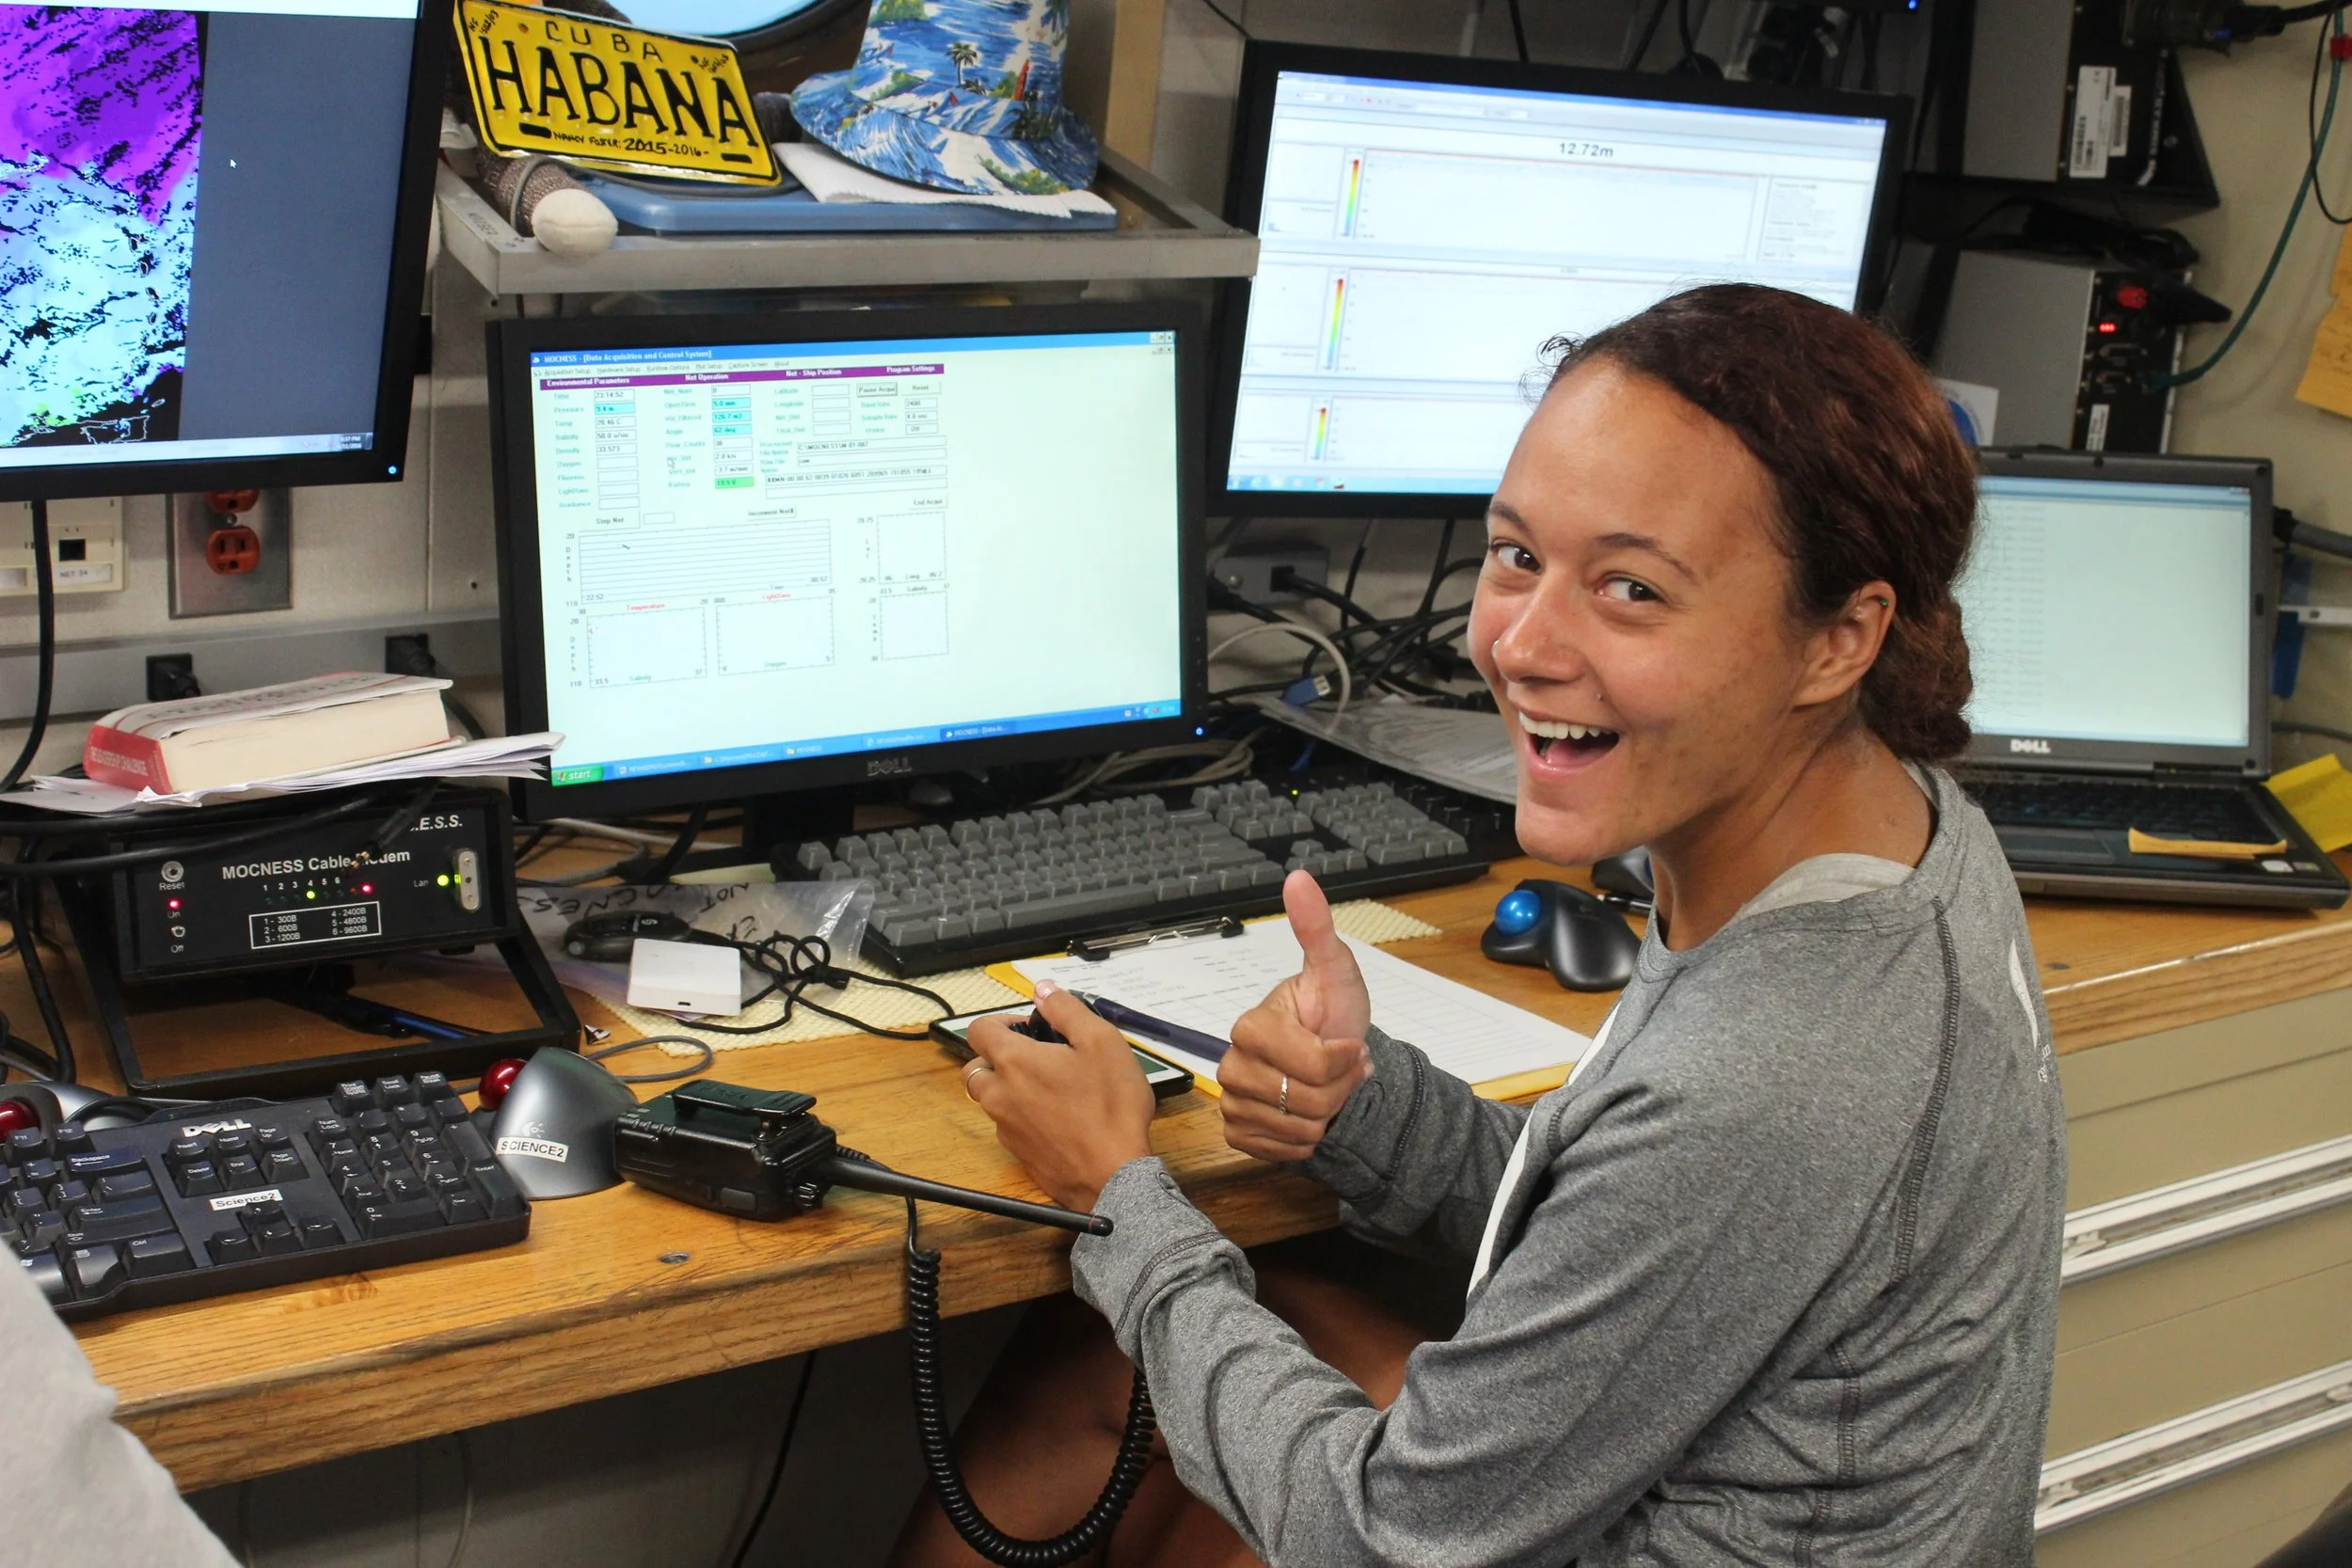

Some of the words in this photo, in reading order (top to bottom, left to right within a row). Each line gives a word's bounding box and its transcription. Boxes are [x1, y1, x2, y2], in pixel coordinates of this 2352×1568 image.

[546, 21, 662, 62] CUBA
[479, 36, 759, 147] HABANA
[1560, 142, 1613, 158] 12.72m
[547, 378, 593, 387] Environmental
[594, 376, 629, 386] Parameters
[698, 373, 729, 382] Operation
[2010, 738, 2051, 753] DELL
[867, 756, 913, 776] DELL
[568, 769, 591, 781] start
[222, 858, 304, 879] MOCNESS
[307, 856, 352, 872] Cable
[158, 881, 185, 891] Reset
[413, 879, 429, 887] Lan
[342, 906, 367, 917] 2400B
[278, 913, 297, 924] 300B
[342, 915, 367, 925] 4800B
[278, 923, 298, 932] 600B
[342, 924, 368, 934] 9600B
[278, 931, 301, 942] 1200B
[171, 943, 184, 953] Off
[182, 1118, 252, 1138] DELL
[501, 1140, 564, 1159] SCIENCE2
[71, 1153, 111, 1164] Backspace
[215, 1192, 276, 1208] Science2
